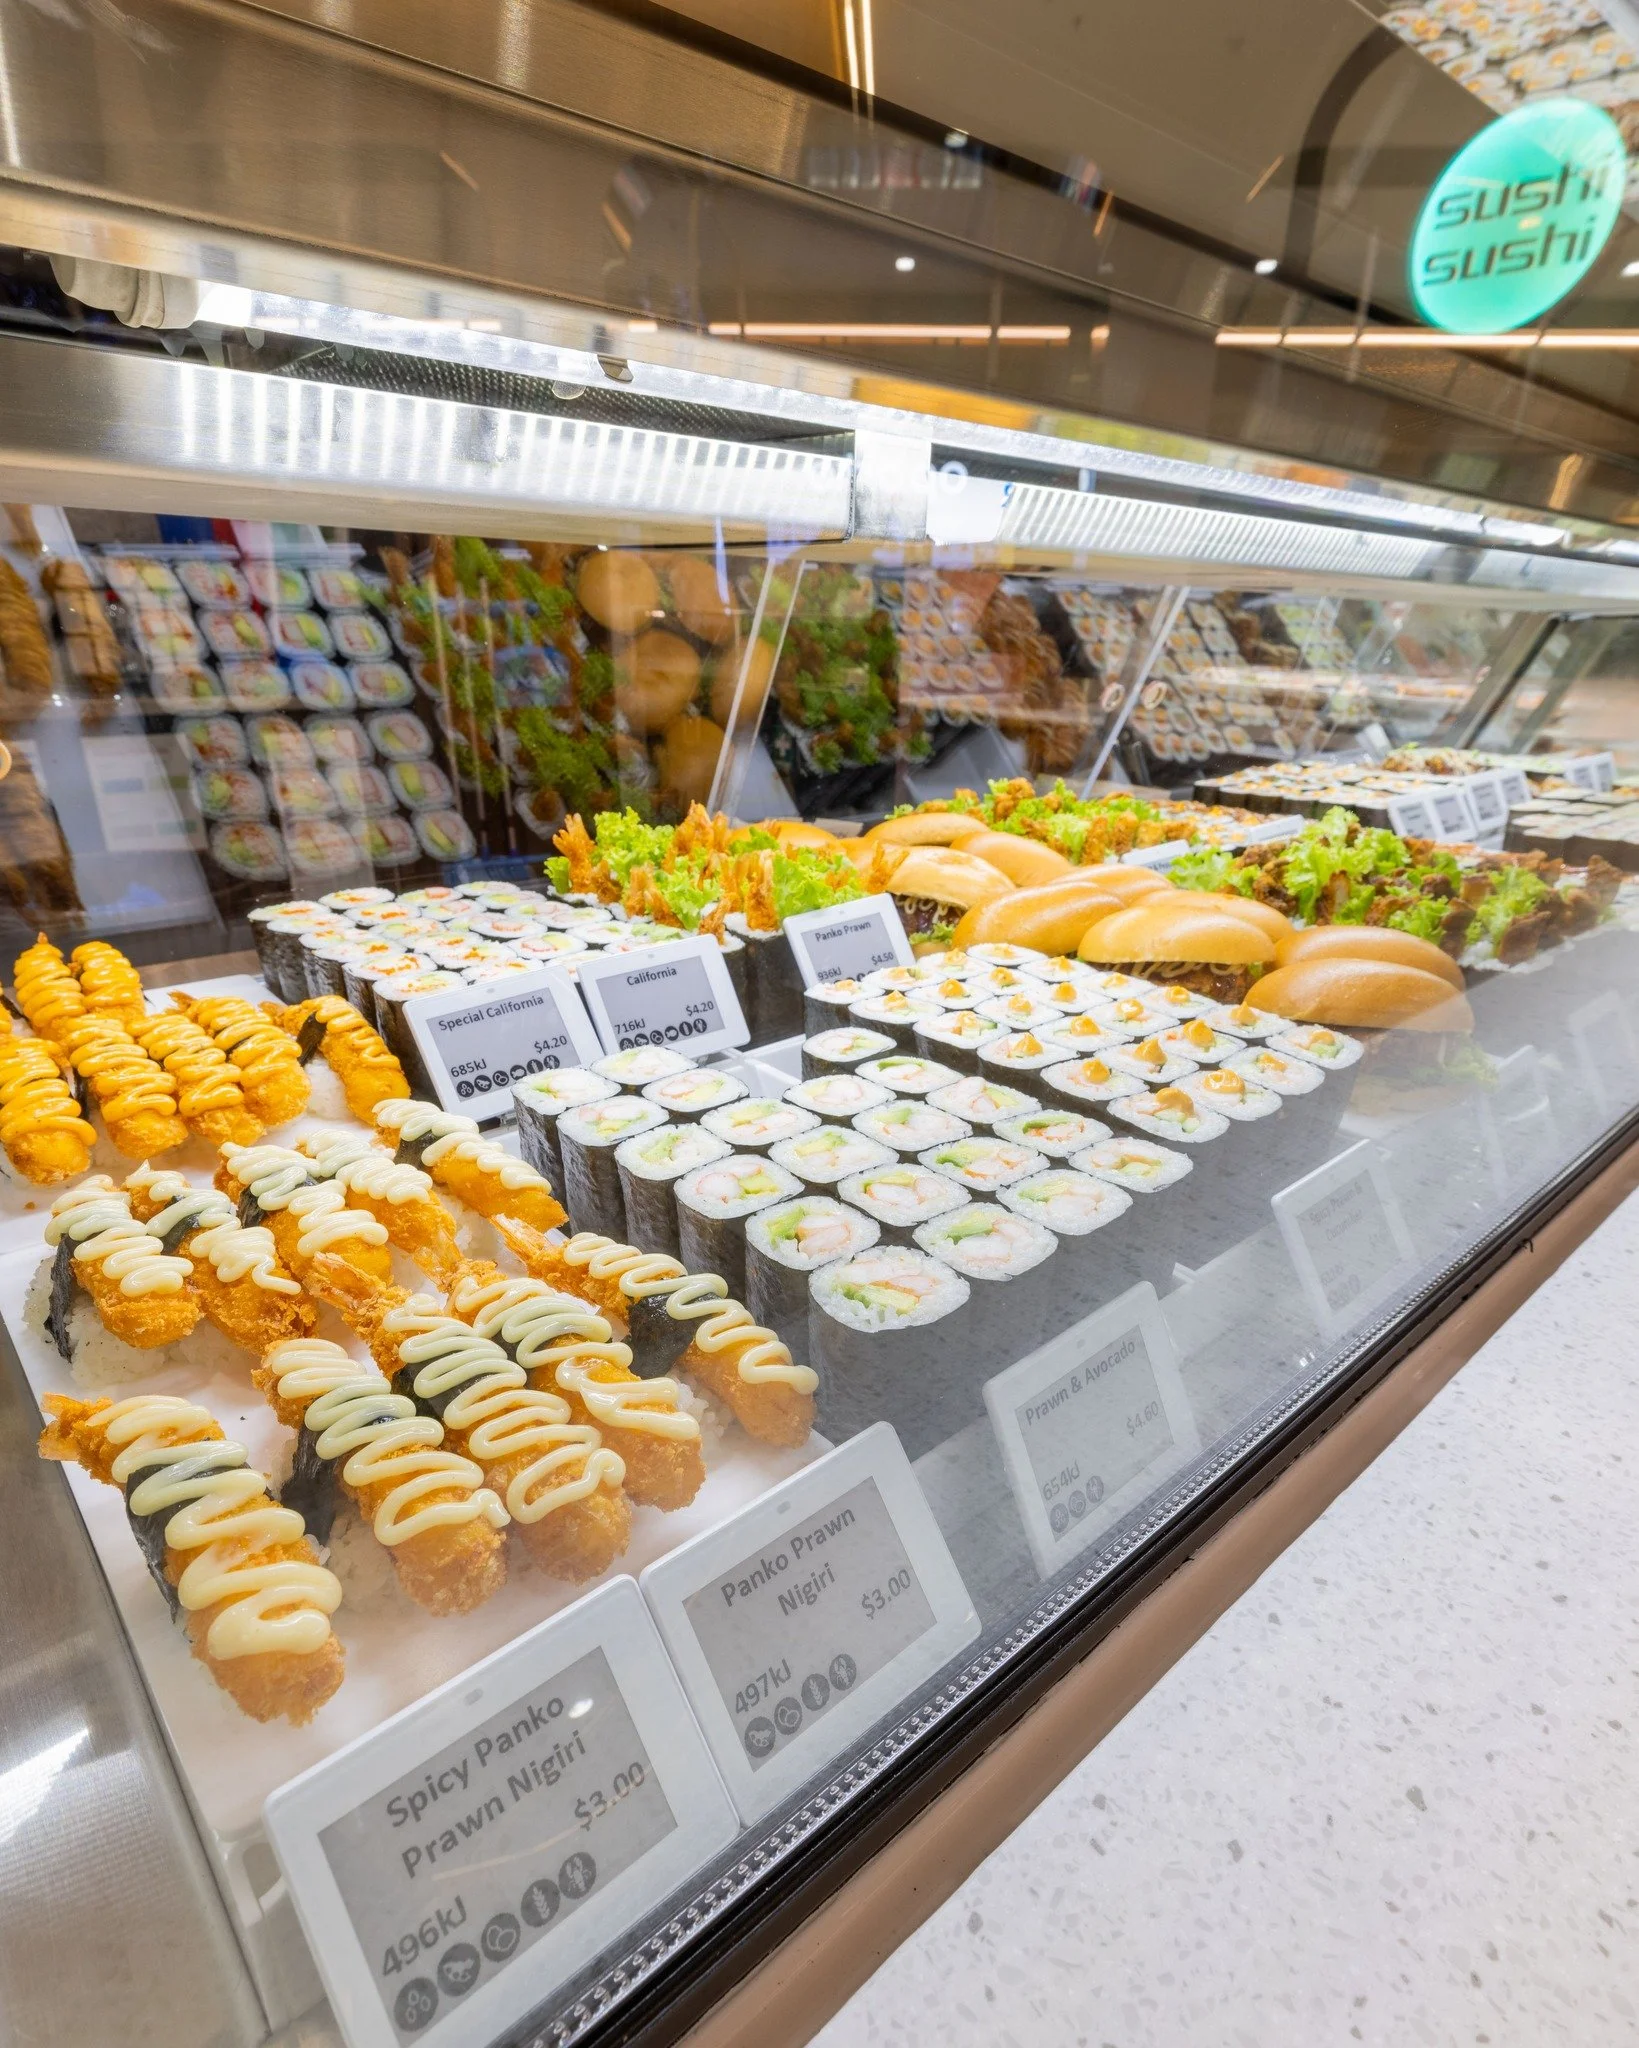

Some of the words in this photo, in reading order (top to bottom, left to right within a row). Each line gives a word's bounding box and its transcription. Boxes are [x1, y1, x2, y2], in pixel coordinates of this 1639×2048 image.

[1434, 159, 1608, 230] sushi
[1422, 213, 1598, 287] sushi
[816, 928, 842, 942] Panko
[844, 922, 871, 935] Prawn
[626, 966, 678, 986] California
[872, 953, 894, 966] $4.50
[438, 1009, 485, 1032] Special
[486, 995, 544, 1019] California
[614, 1018, 646, 1035] 716kJ
[685, 1000, 715, 1017] $4.20
[450, 1058, 488, 1078] 685kJ
[534, 1035, 568, 1054] $4.20
[1025, 1387, 1070, 1427] Prawn
[1070, 1374, 1083, 1395] &
[1084, 1339, 1136, 1386] Avocado
[1126, 1400, 1160, 1438] $4.60
[720, 1552, 789, 1608] Panko
[790, 1507, 857, 1560] Prawn
[777, 1562, 836, 1617] Nigiri
[860, 1568, 912, 1620] $3.00
[734, 1657, 793, 1715] 497kJ
[385, 1757, 470, 1829] Spicy
[474, 1696, 565, 1768] Panko
[400, 1795, 506, 1879] Prawn
[506, 1729, 587, 1805] Nigiri
[574, 1761, 646, 1831] $3.00
[382, 1894, 468, 1979] 496kJ
